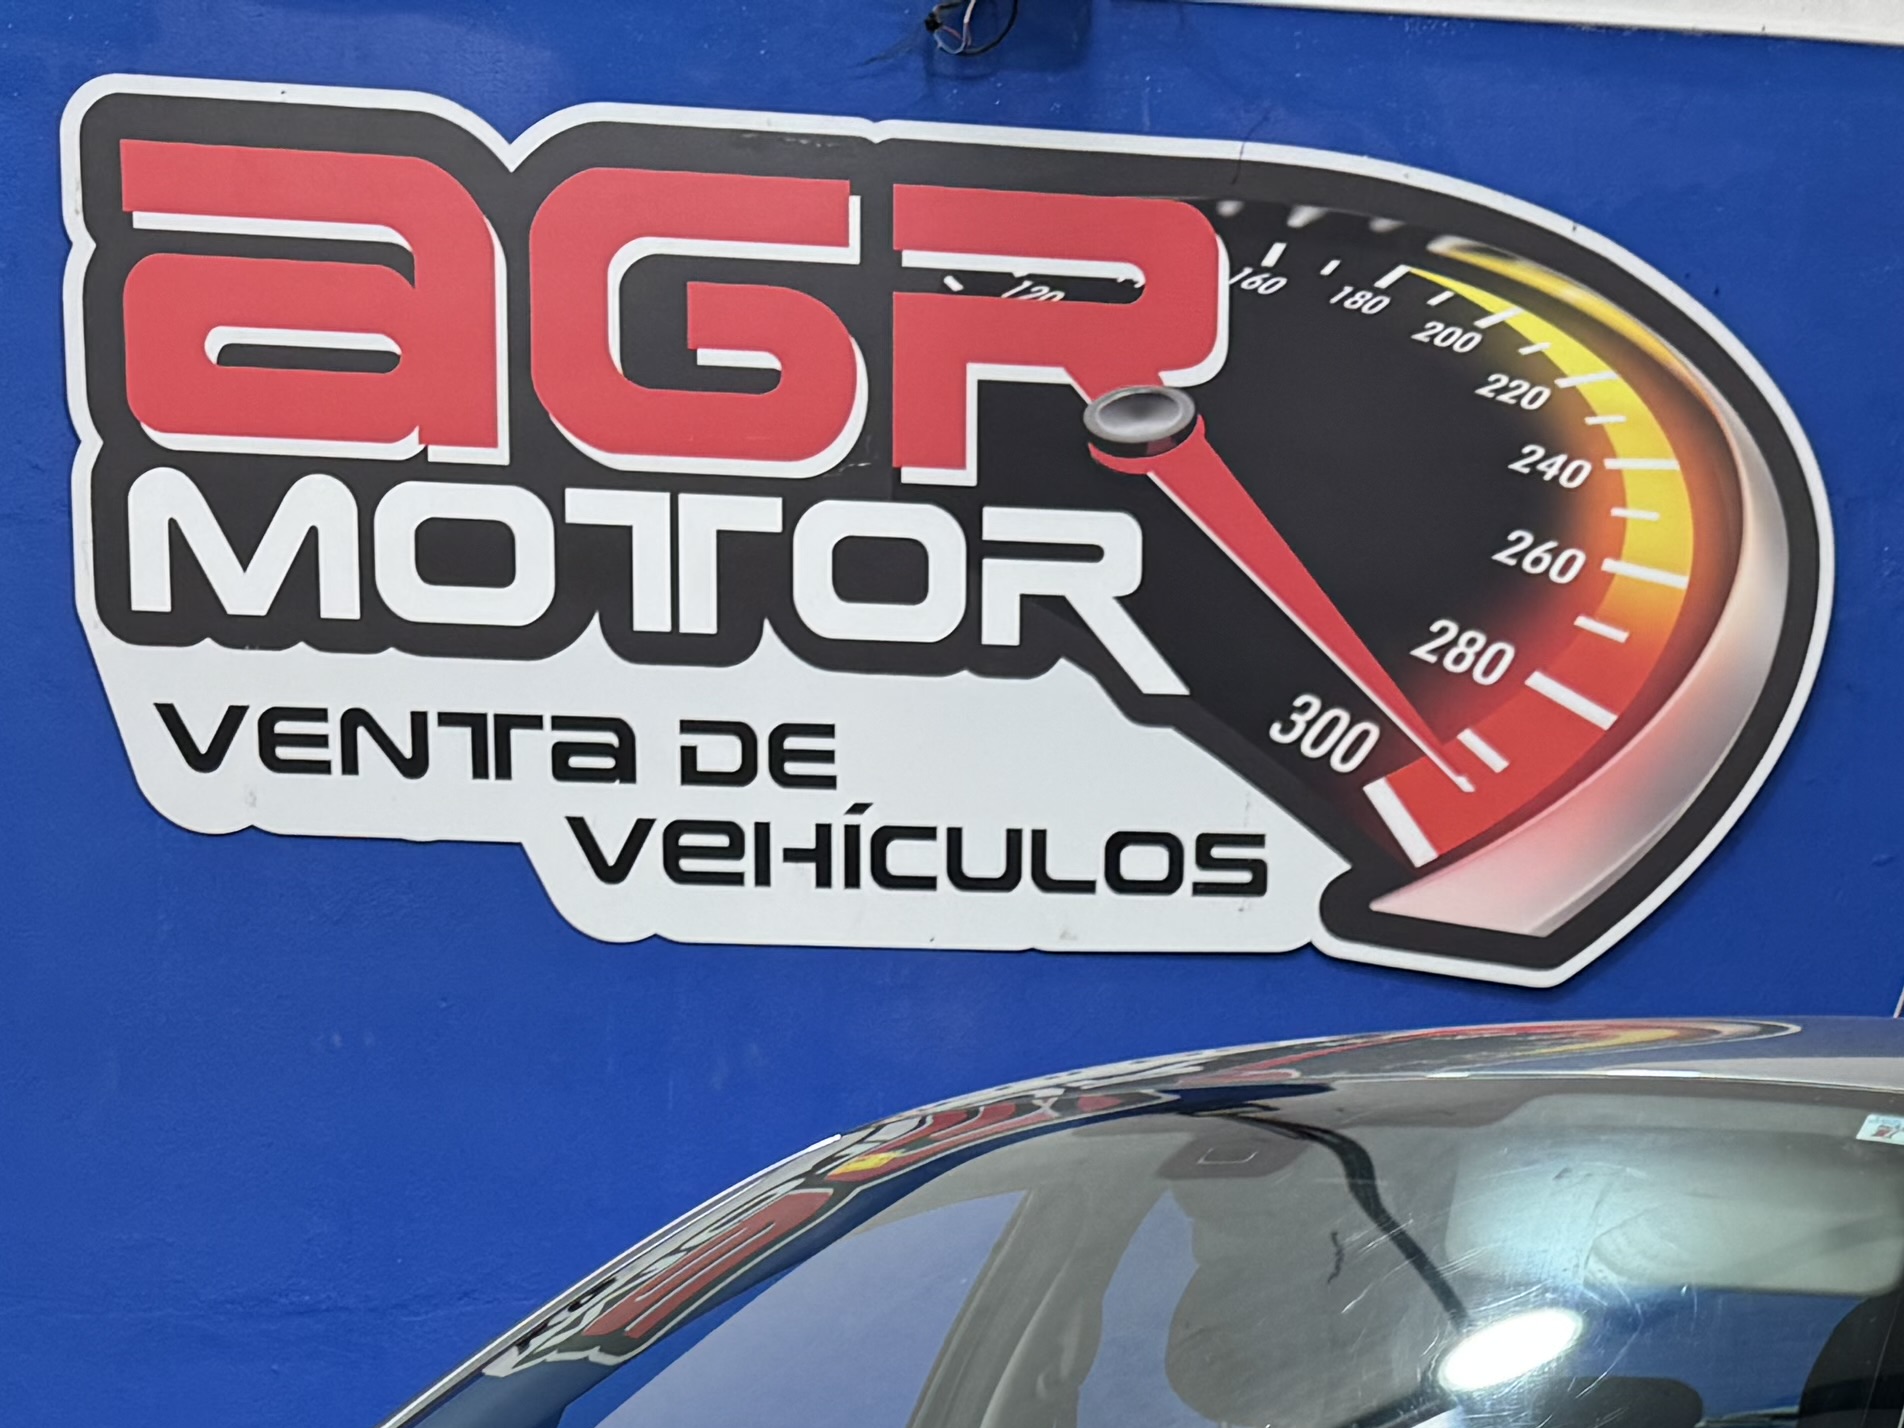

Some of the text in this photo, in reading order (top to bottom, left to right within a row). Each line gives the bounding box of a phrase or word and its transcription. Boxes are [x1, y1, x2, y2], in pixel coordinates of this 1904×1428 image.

[1228, 267, 1288, 295] 160
[1329, 285, 1391, 315] 180
[1411, 320, 1483, 355] 200
[1474, 373, 1552, 412] 220
[1507, 444, 1593, 490] 240
[126, 467, 1191, 696] MOTOR
[1491, 529, 1587, 586] 260
[1409, 618, 1516, 687] 280
[679, 718, 838, 790] DE
[1268, 693, 1381, 775] 300
